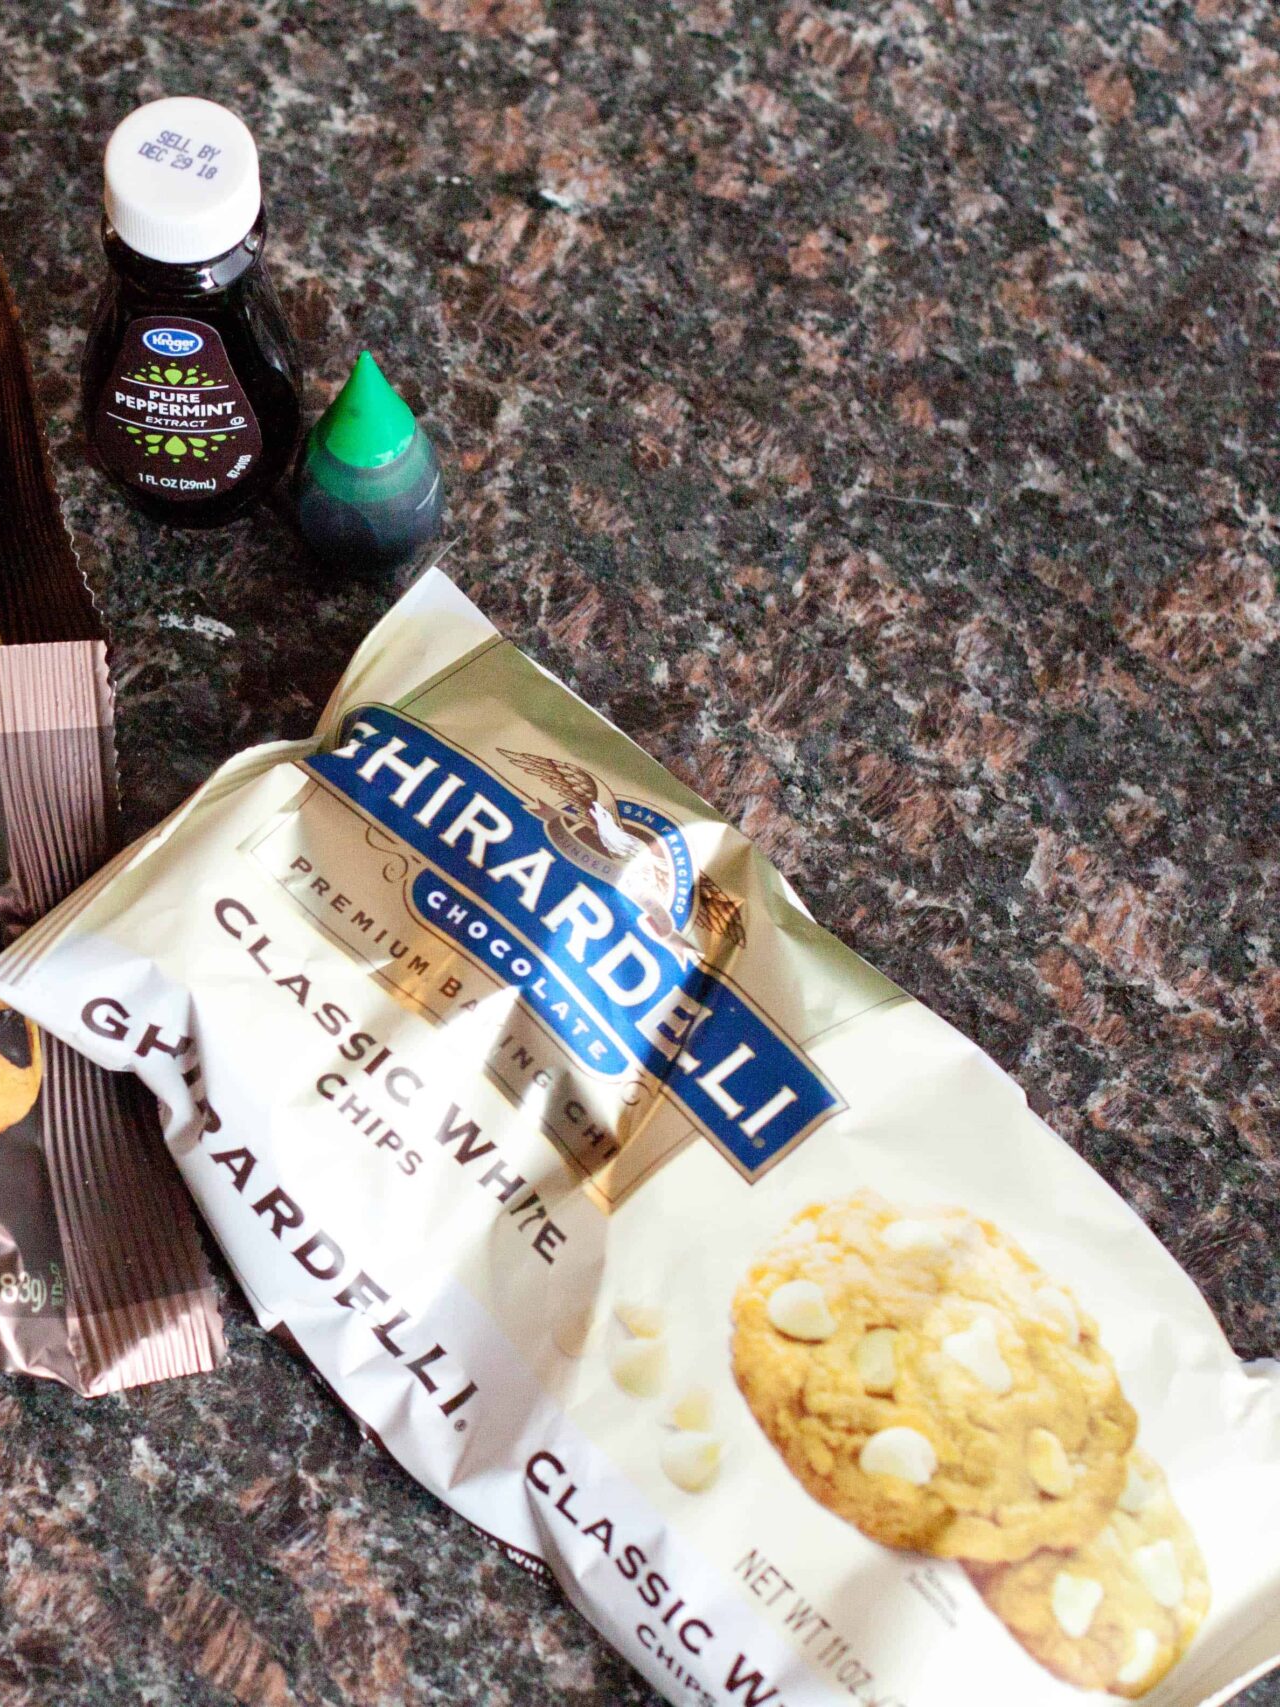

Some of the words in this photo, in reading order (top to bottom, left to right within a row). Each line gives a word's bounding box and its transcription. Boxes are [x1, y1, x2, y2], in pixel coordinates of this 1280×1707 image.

[138, 142, 168, 162] DEC
[170, 154, 193, 170] 29
[196, 164, 218, 180] 18
[156, 130, 191, 153] SELL
[197, 144, 221, 162] BY
[152, 332, 196, 352] Kroger
[115, 391, 236, 417] PEPPERMINT
[145, 416, 208, 428] EXTRACT
[149, 390, 200, 404] PURE
[145, 475, 158, 486] FL
[160, 478, 178, 489] OZ
[180, 478, 216, 491] (29mL)
[623, 805, 655, 823] SAN
[661, 825, 688, 914] FRANCISCO
[331, 721, 798, 1139] HIRARDELI
[426, 890, 608, 1061] CHOCOLATE
[290, 855, 430, 976] PREMIUM
[439, 976, 553, 1089] BAING
[564, 1100, 620, 1161] CHI
[213, 897, 424, 1107] CLASSIC
[434, 1101, 568, 1266] WHITE
[316, 1072, 423, 1177] CHIPS
[526, 1451, 714, 1657] CLASSIC
[734, 1548, 794, 1607] NET
[784, 1598, 831, 1647] WT
